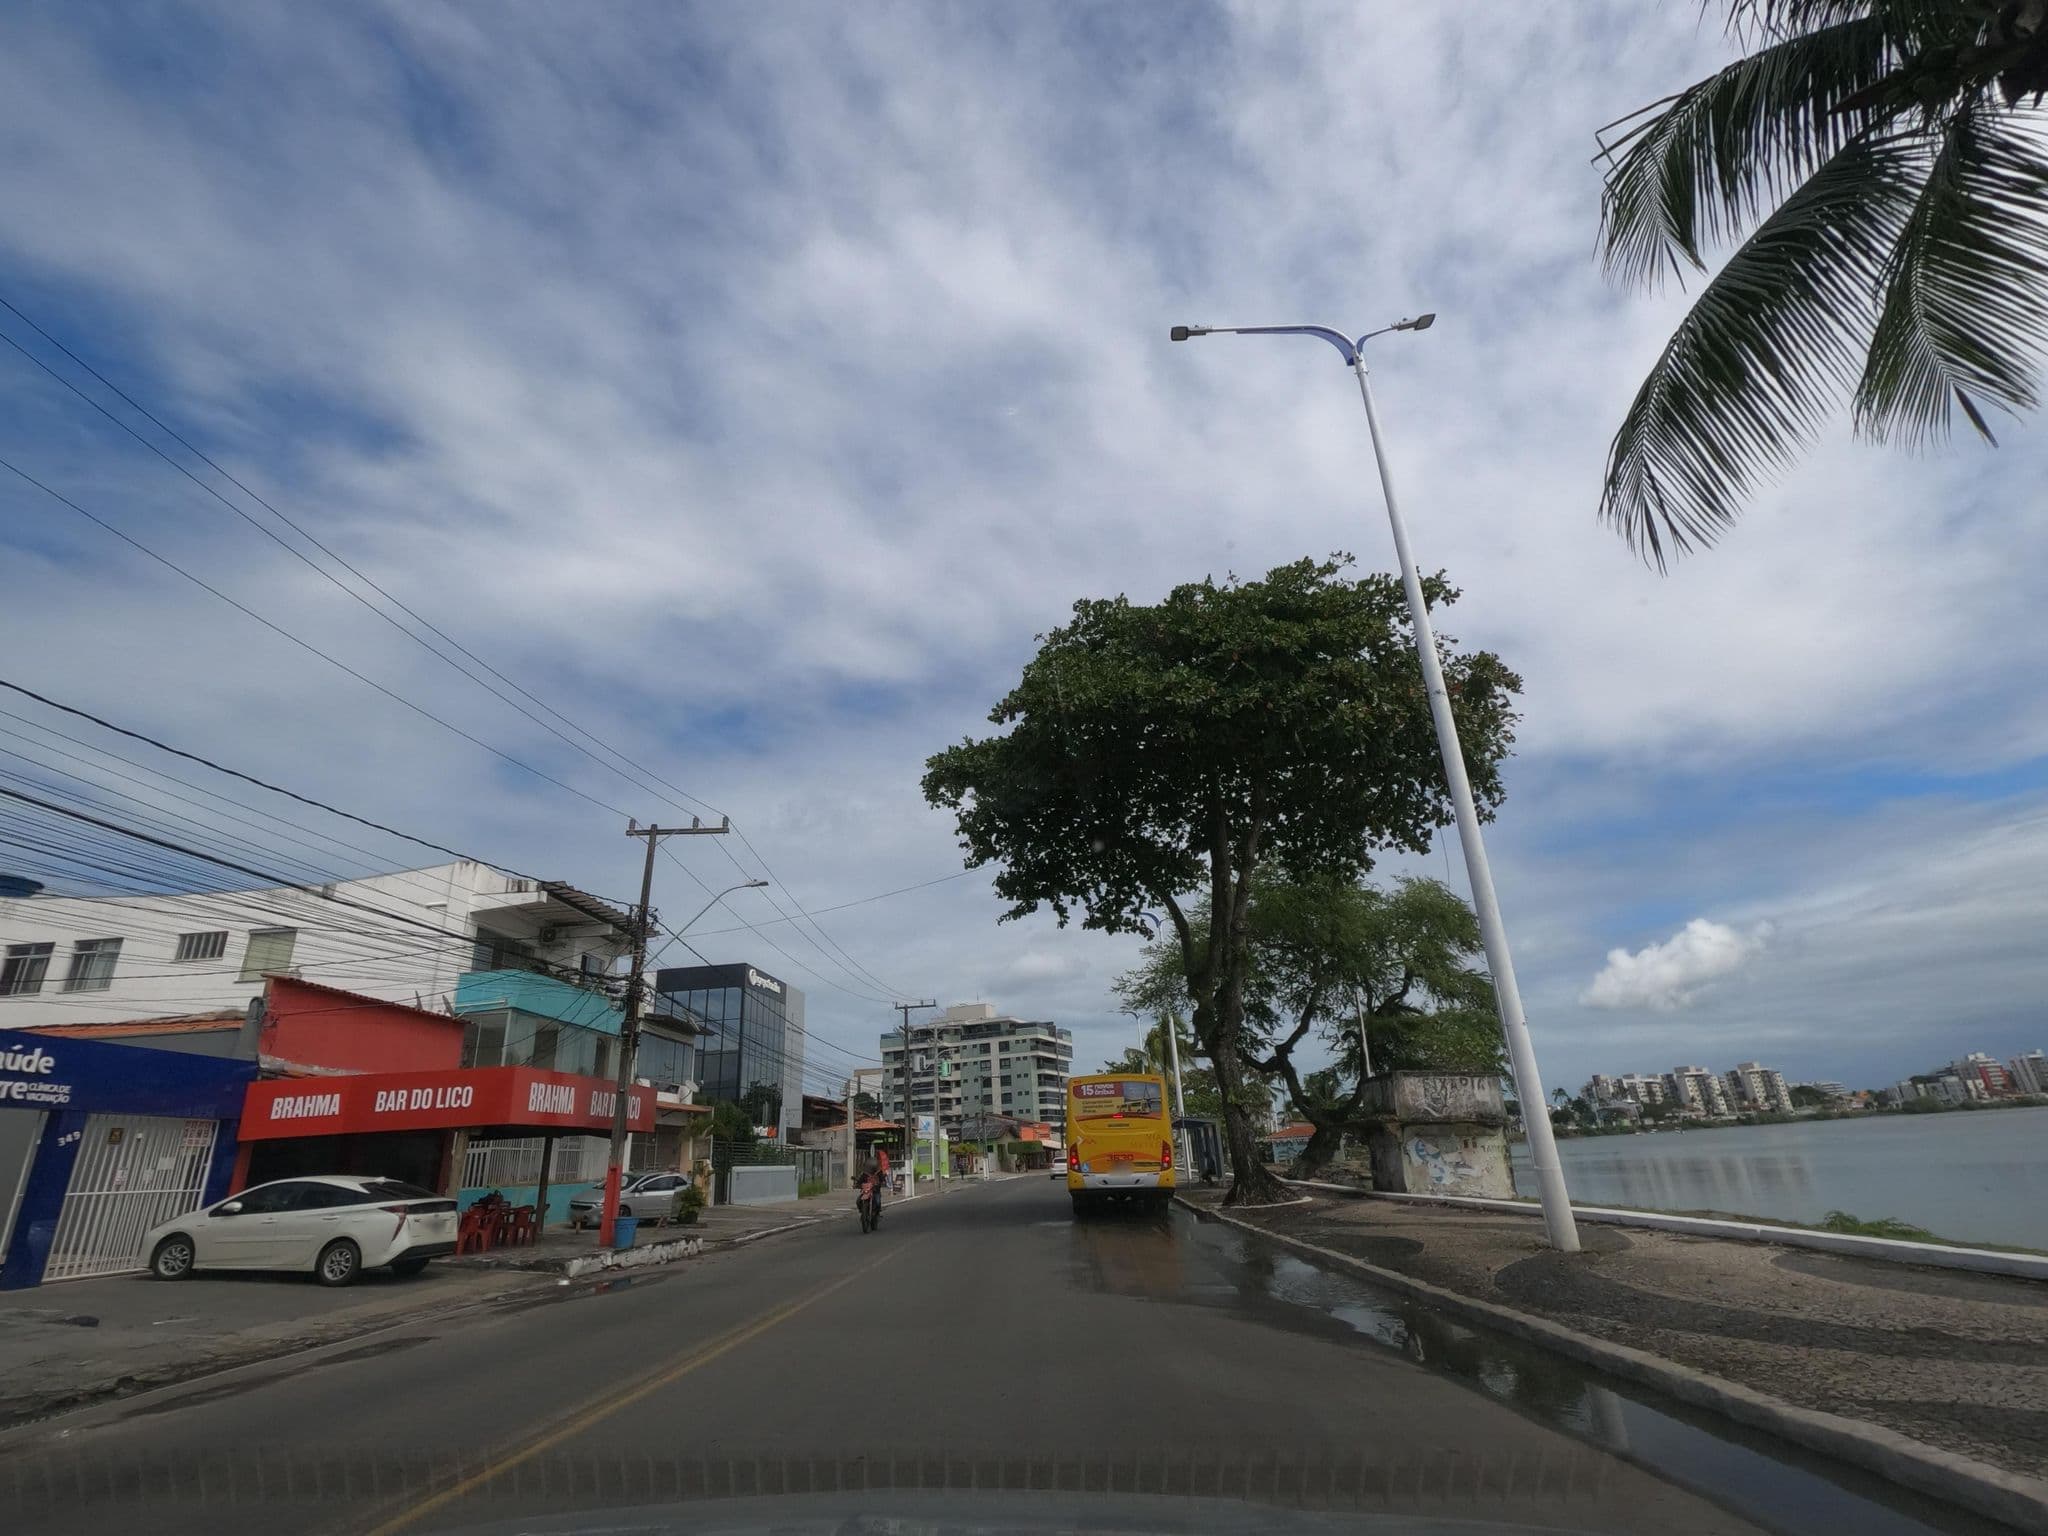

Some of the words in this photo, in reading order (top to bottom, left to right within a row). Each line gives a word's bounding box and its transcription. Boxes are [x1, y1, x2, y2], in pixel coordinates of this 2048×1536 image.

[375, 1089, 407, 1112] BAR
[410, 1087, 433, 1110] DO
[436, 1085, 474, 1109] LICO
[528, 1082, 575, 1115] BRAHMA
[1081, 1085, 1094, 1096] 15
[270, 1093, 341, 1120] BRAHMA
[590, 1091, 608, 1117] BAR
[626, 1095, 641, 1120] ICO
